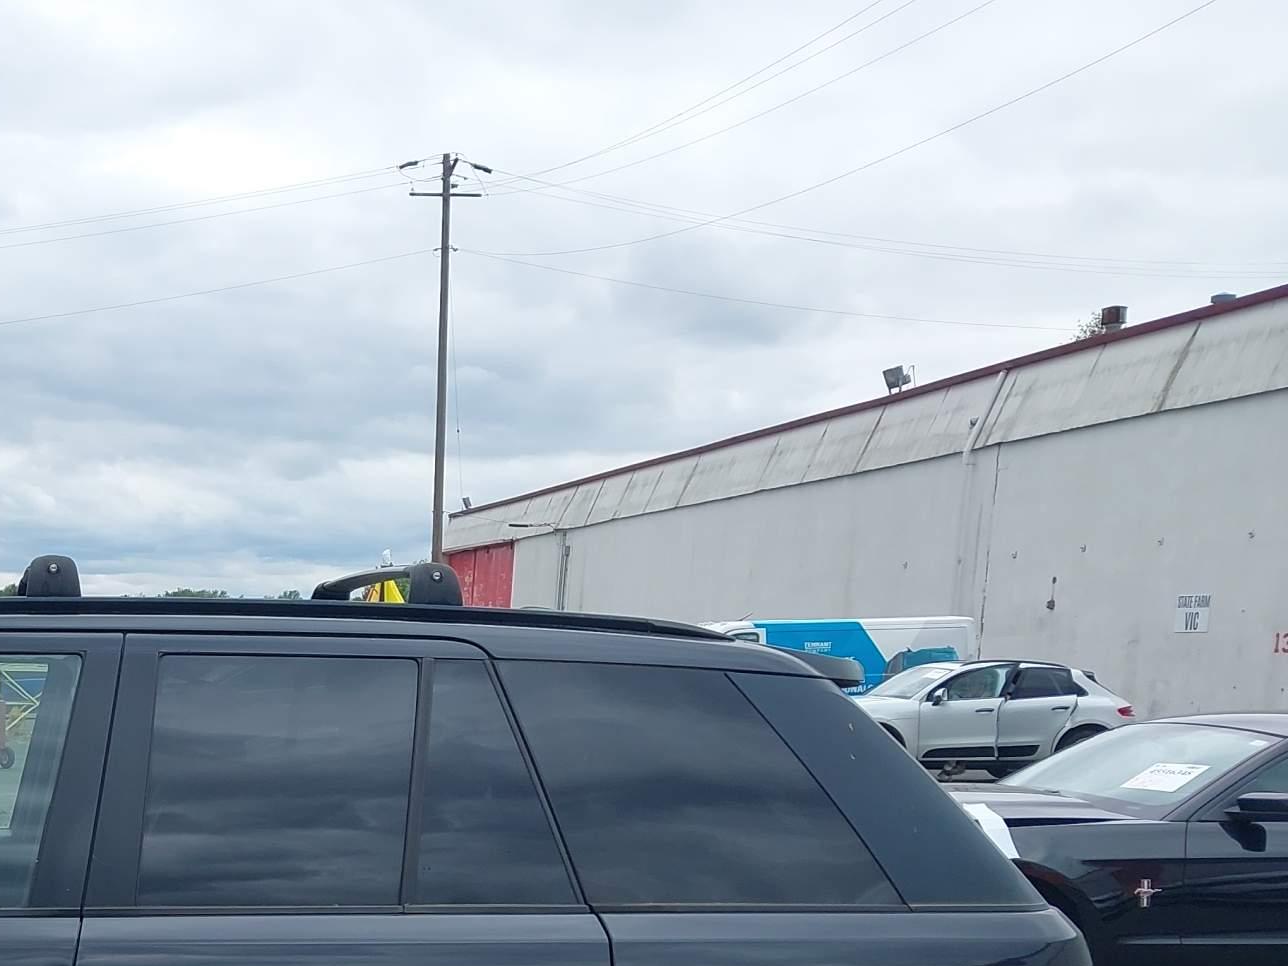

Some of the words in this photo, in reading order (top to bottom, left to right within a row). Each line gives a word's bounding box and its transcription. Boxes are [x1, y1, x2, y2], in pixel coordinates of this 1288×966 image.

[1177, 595, 1193, 608] STATE
[1194, 595, 1211, 608] FARM
[1184, 612, 1199, 630] VIC
